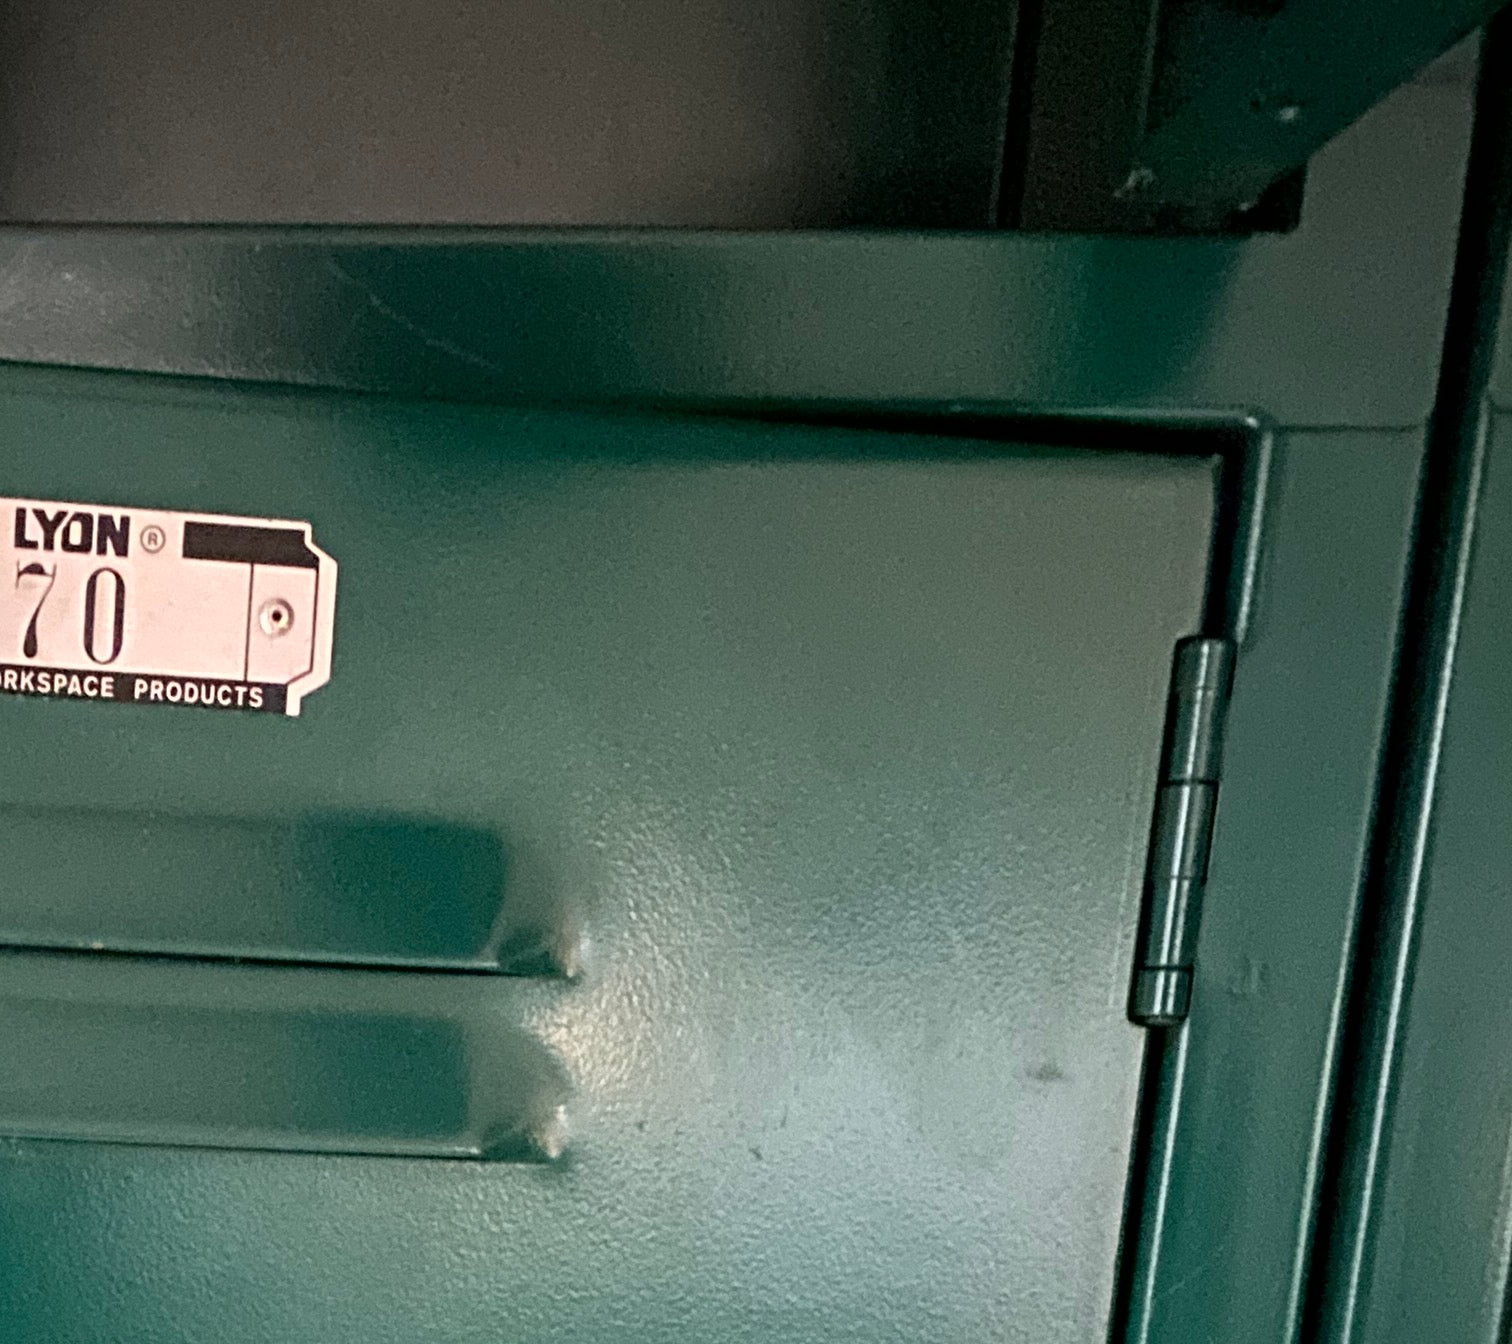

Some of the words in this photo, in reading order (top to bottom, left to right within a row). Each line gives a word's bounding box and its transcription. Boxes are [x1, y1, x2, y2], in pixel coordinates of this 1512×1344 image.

[13, 507, 131, 558] LYON
[15, 560, 126, 665] 70
[133, 678, 264, 708] PRODUCTS
